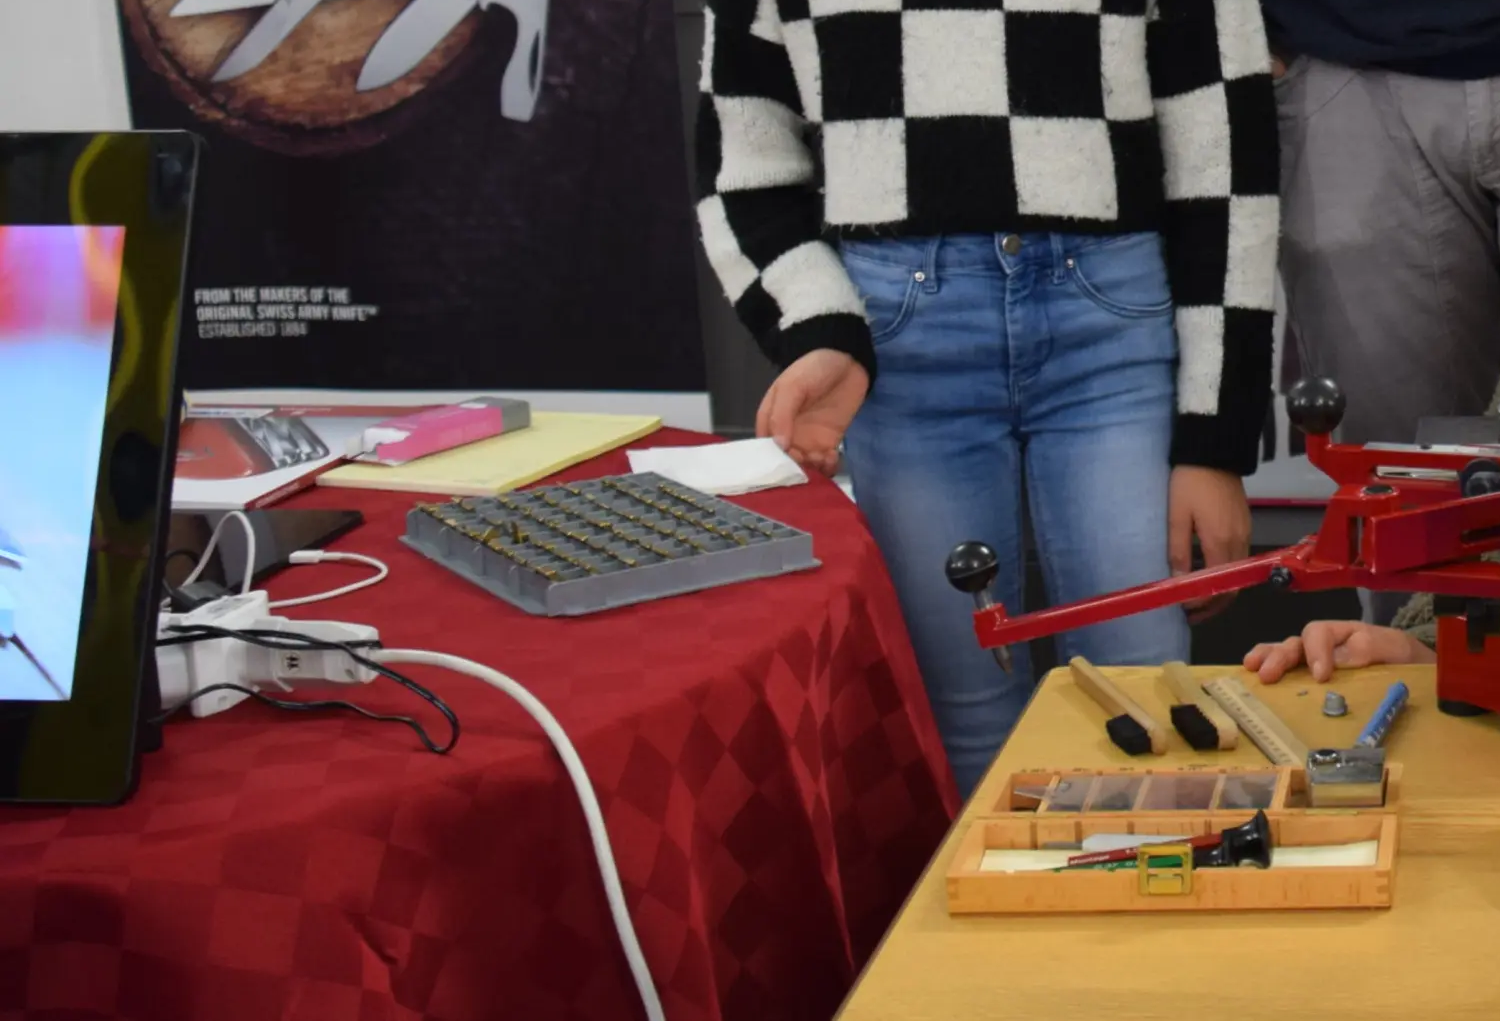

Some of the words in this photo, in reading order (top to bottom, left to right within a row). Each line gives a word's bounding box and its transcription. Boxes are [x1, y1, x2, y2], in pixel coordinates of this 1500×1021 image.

[194, 288, 231, 304] FROM
[233, 287, 257, 304] THE
[259, 287, 308, 304] MAKERS
[310, 287, 324, 303] OF
[327, 287, 349, 304] THE
[196, 305, 254, 321] ORIGINAL
[256, 304, 296, 320] SWISS
[298, 304, 330, 320] ARMY
[198, 322, 276, 338] ESTABLISHED
